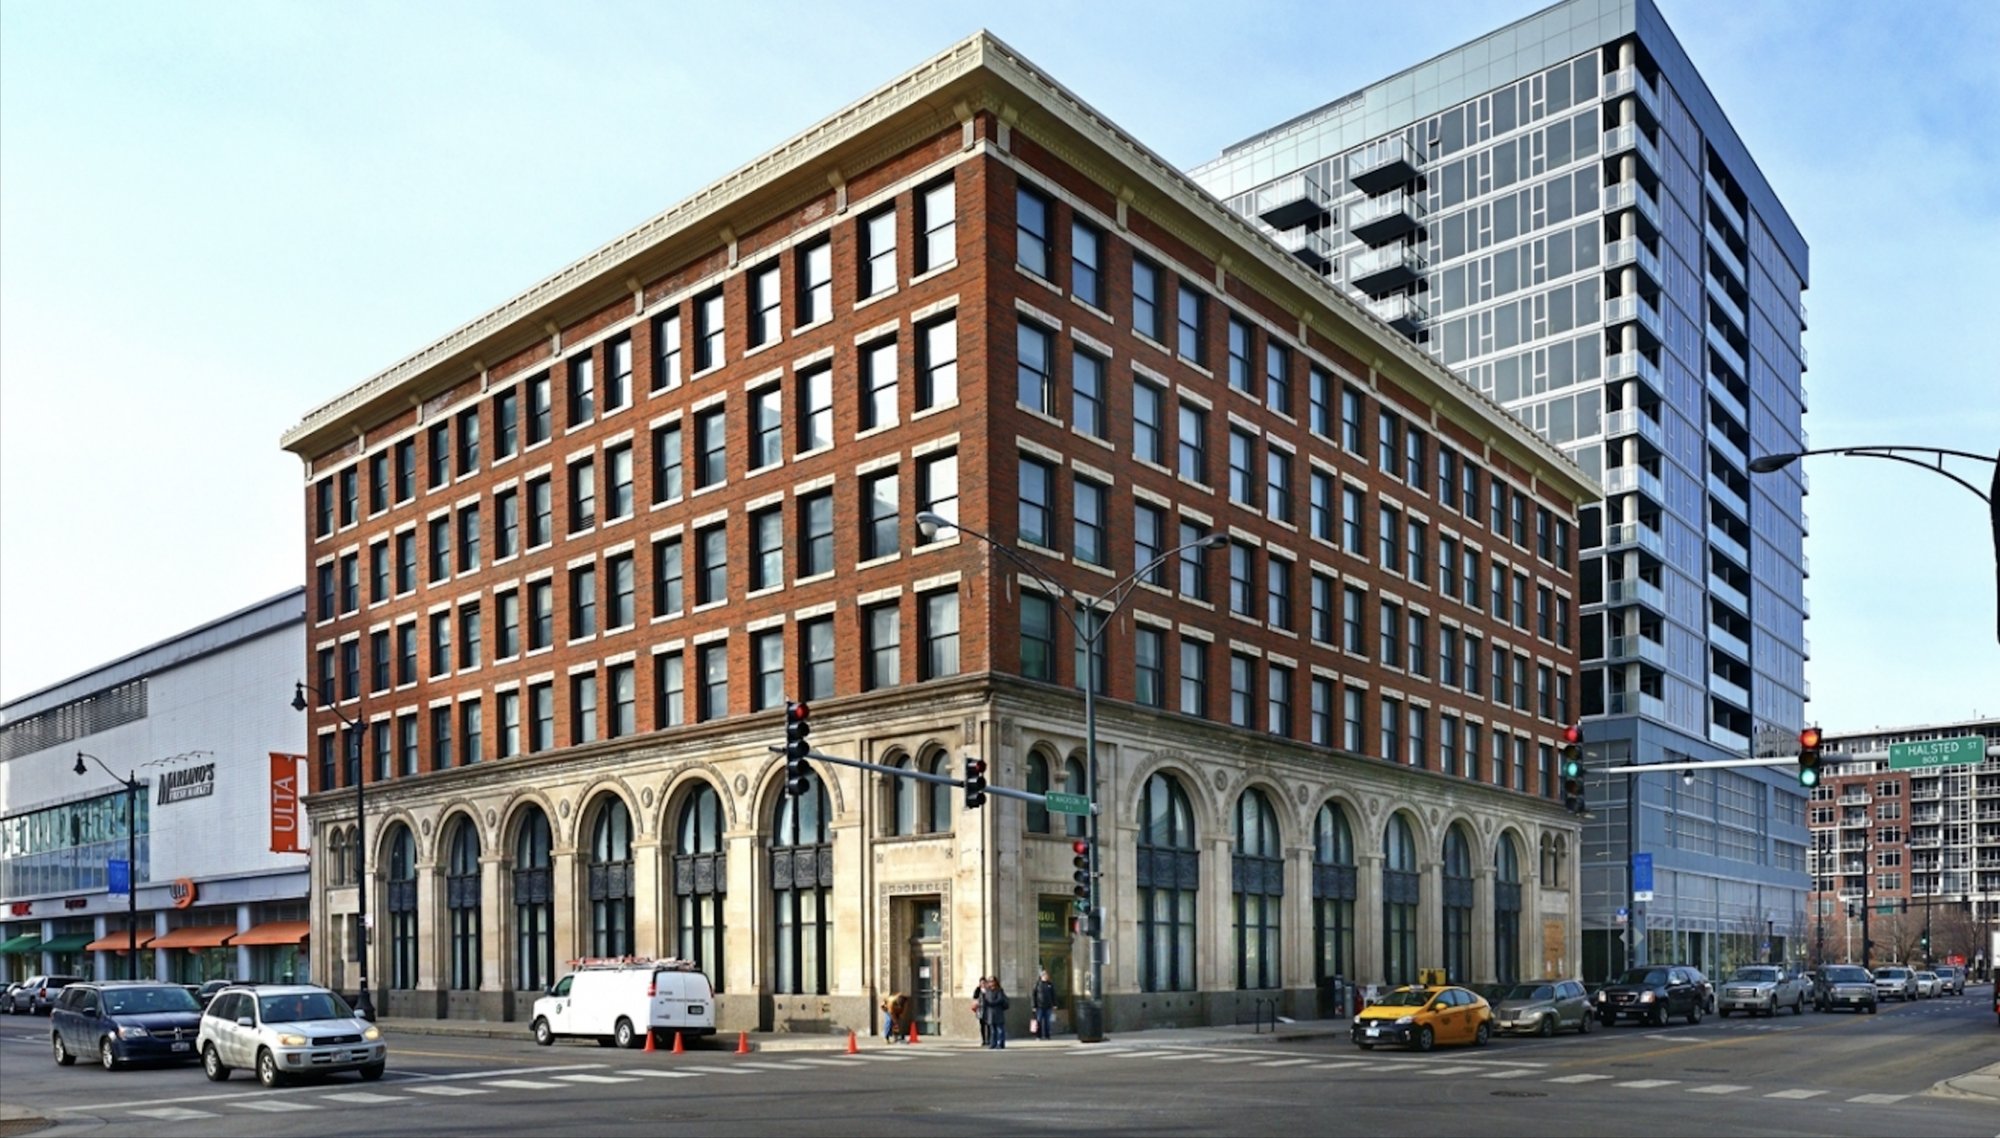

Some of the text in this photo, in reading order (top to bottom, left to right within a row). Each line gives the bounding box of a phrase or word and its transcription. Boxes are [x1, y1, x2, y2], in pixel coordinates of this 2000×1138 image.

[1907, 742, 1959, 756] HALSTED
[1967, 742, 1977, 750] ST
[1922, 755, 1938, 764] 800
[273, 776, 295, 832] ULTA
